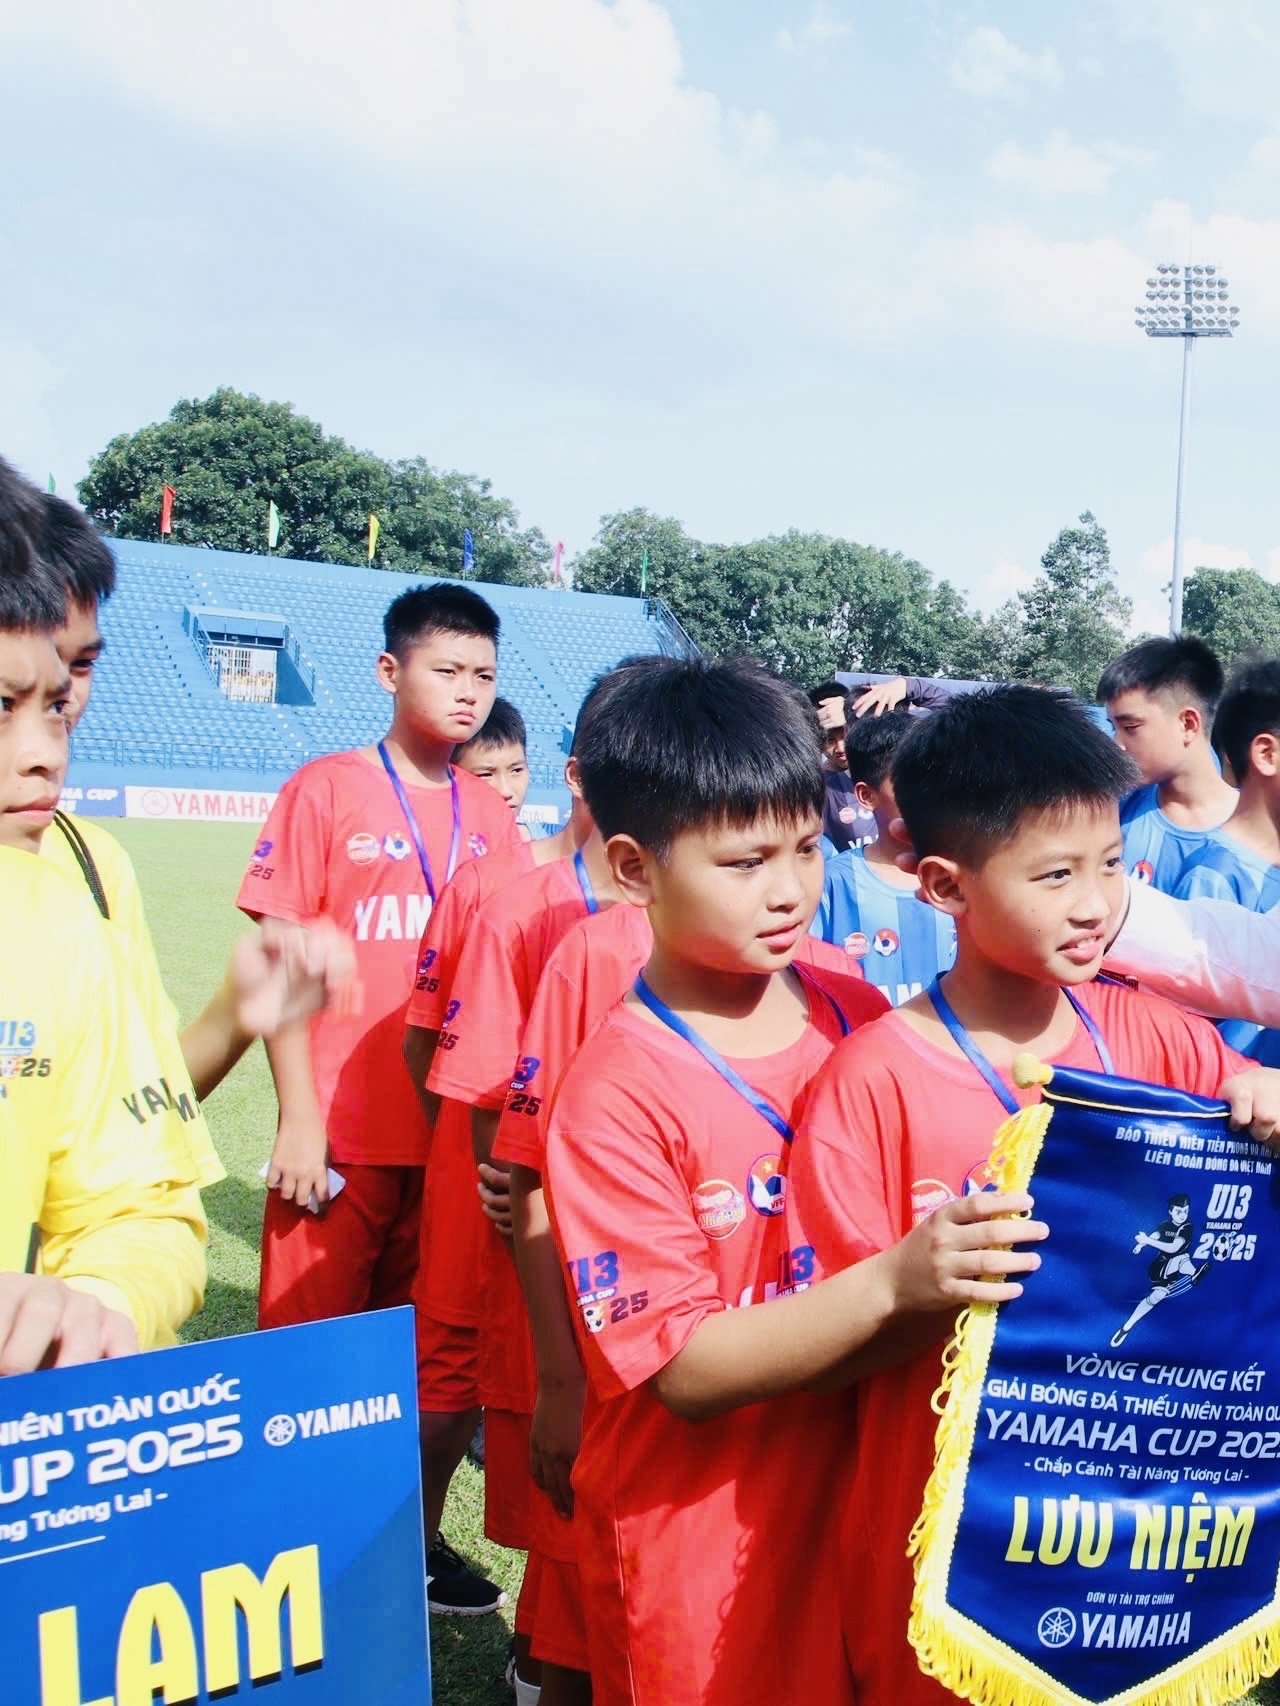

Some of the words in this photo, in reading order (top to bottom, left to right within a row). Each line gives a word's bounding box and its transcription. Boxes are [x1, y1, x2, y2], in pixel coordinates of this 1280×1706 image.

[249, 865, 275, 880] 25
[415, 976, 440, 992] 25
[508, 1093, 542, 1116] 25
[1115, 1125, 1142, 1143] BÁO
[1179, 1134, 1205, 1151] NIÊN
[1143, 1149, 1172, 1166] LIÊN
[1174, 1152, 1204, 1170] ĐOÀN
[1205, 1155, 1228, 1172] BÓNG
[1206, 1183, 1253, 1220] U13
[1206, 1221, 1232, 1231] YAMAHA
[1232, 1222, 1243, 1231] CUP
[610, 1290, 649, 1324] 25
[1066, 1353, 1139, 1381] VÒNG
[1142, 1364, 1227, 1391] CHUNG
[1230, 1362, 1266, 1392] KẾT
[67, 1395, 153, 1428] TOÀN
[158, 1373, 241, 1415] QUỐC
[296, 1393, 402, 1439] YAMAHA
[987, 1376, 1027, 1400] GIẢI
[1030, 1381, 1088, 1408] BÓNG
[1090, 1388, 1119, 1412] ĐÁ
[1123, 1394, 1178, 1418] THIẾU
[1181, 1399, 1222, 1421] NIÊN
[1225, 1401, 1264, 1422] TOÀN
[86, 1414, 244, 1485] 2025
[985, 1407, 1139, 1454] YAMAHA
[1147, 1428, 1217, 1457] CUP
[1034, 1456, 1073, 1477] Chắp
[1075, 1460, 1114, 1478] Cánh
[1118, 1464, 1141, 1480] Tài
[1144, 1466, 1179, 1484] Năng
[1183, 1467, 1222, 1484] Tương
[1224, 1467, 1243, 1482] Lai
[30, 1499, 111, 1532] Tương
[115, 1488, 152, 1513] Lai
[1005, 1493, 1115, 1568] LƯU
[1129, 1491, 1256, 1584] NIỆM
[1119, 1592, 1133, 1605] TÀI
[1151, 1592, 1175, 1605] CHÍNH
[38, 1544, 325, 1706] LAM
[1081, 1611, 1192, 1649] YAMAHA
